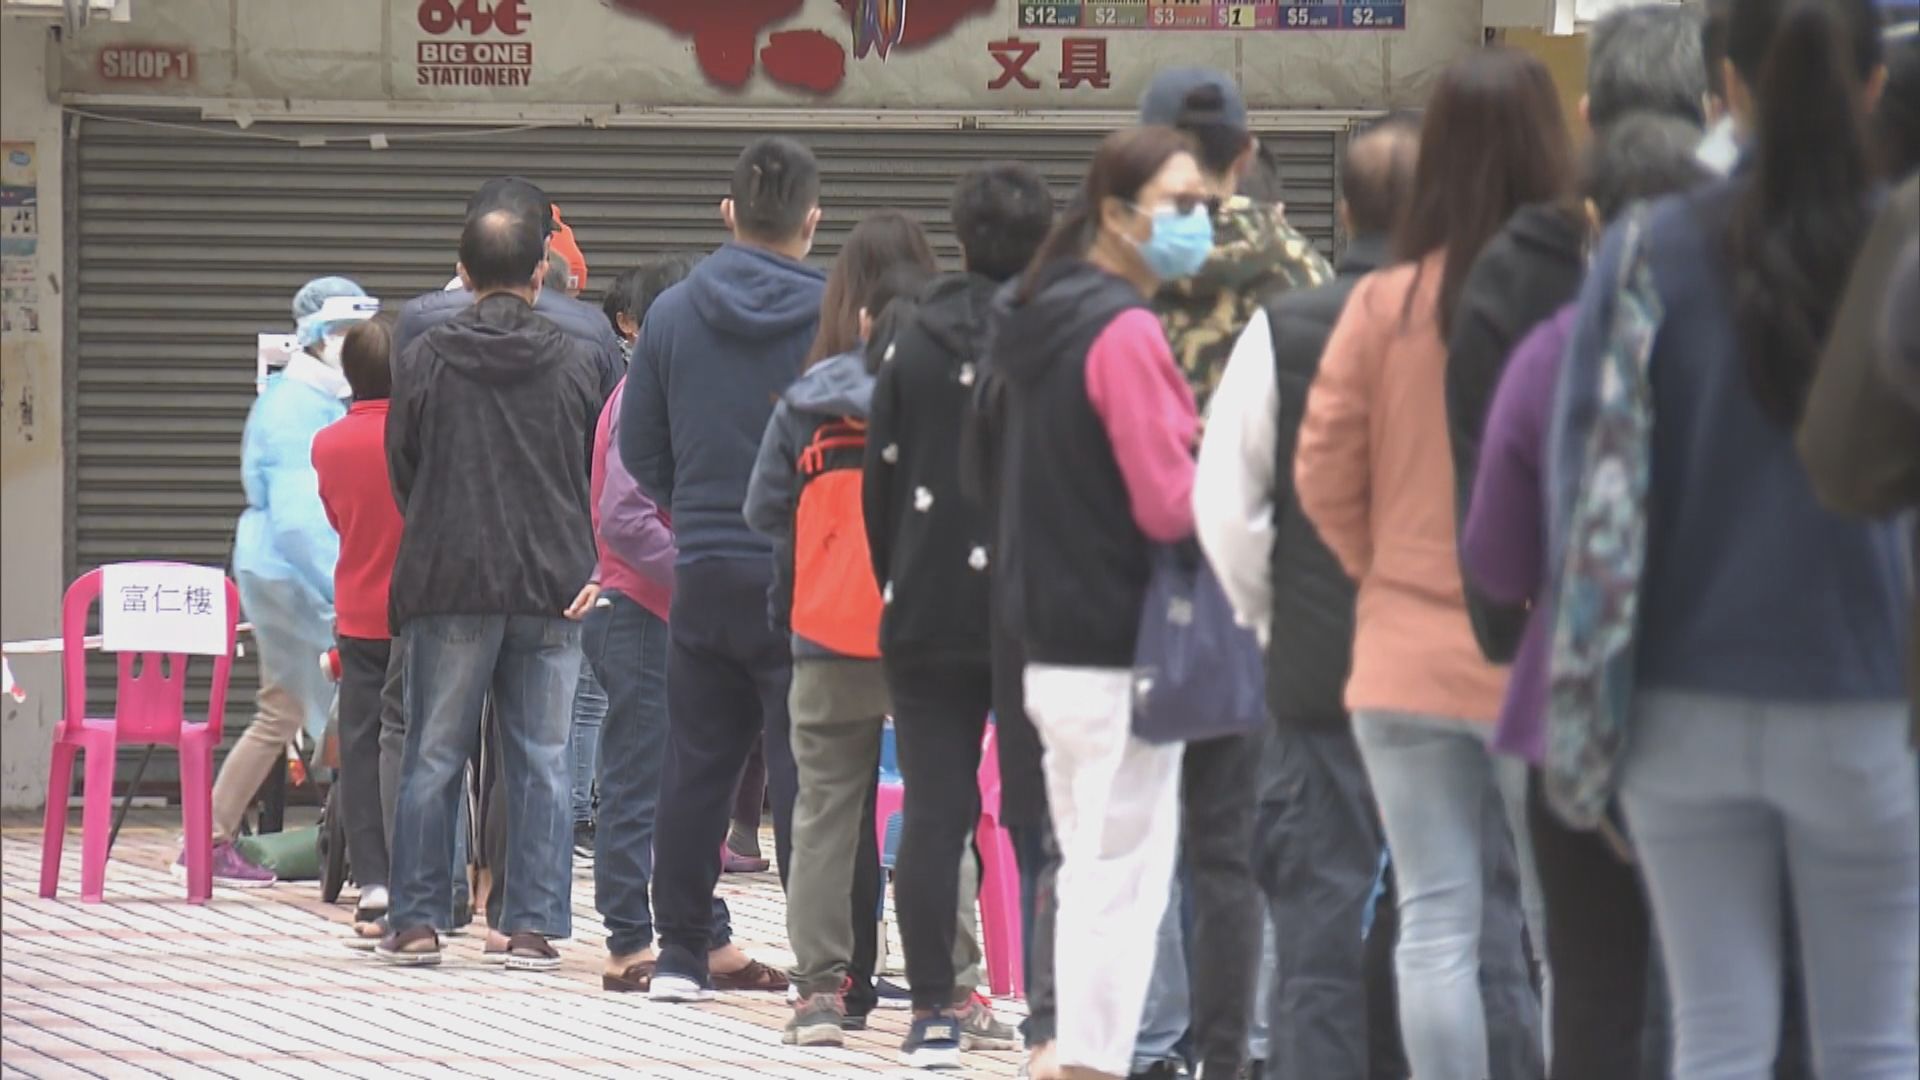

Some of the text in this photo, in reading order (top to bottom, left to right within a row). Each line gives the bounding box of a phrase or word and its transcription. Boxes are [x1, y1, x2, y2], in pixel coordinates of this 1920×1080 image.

[1024, 6, 1057, 24] $12
[1095, 7, 1116, 24] $2
[1153, 7, 1175, 24] $3
[1287, 7, 1309, 25] $5
[1352, 7, 1374, 25] $2
[421, 43, 528, 63] BIG ONE
[987, 36, 1110, 89] 文具
[103, 50, 188, 79] SHOP 1
[417, 66, 531, 86] STATIONERY
[120, 584, 213, 615] 富仁樓
